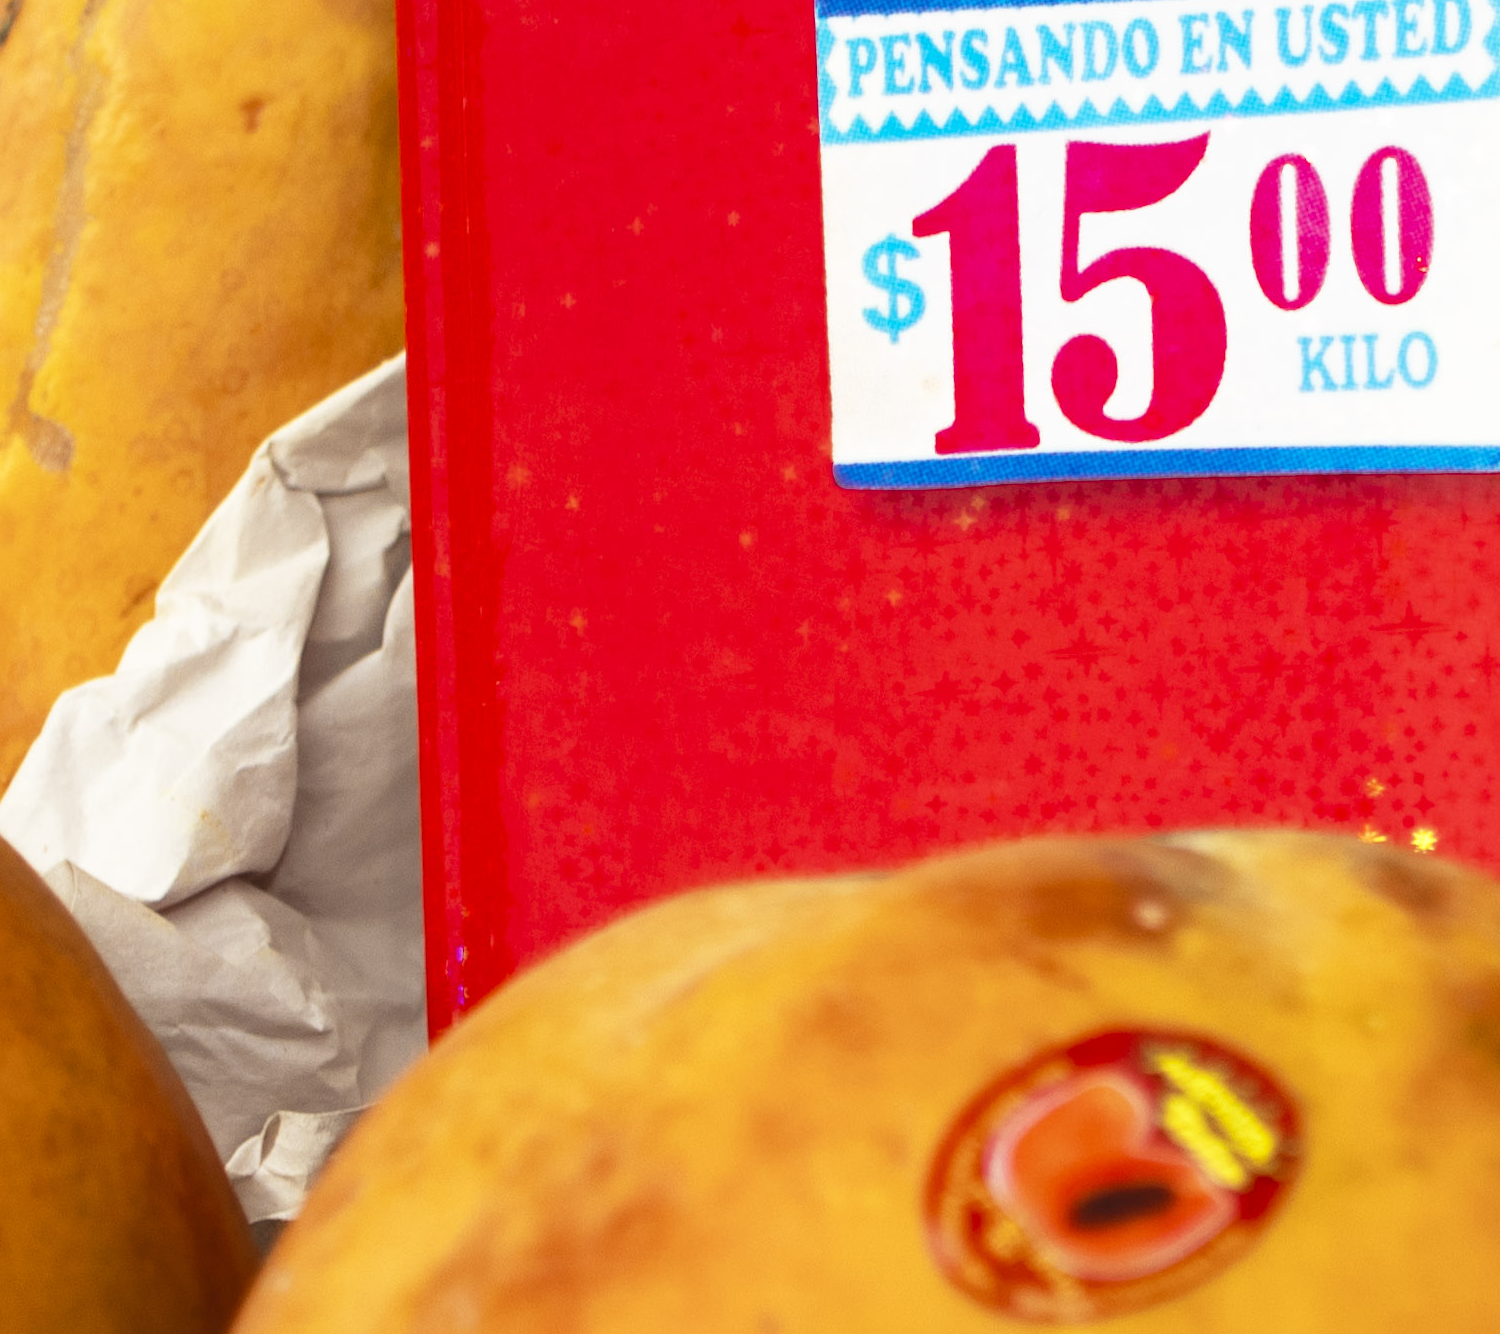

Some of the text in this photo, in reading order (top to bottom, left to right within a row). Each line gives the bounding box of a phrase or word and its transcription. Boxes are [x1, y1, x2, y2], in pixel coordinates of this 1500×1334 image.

[846, 17, 1160, 98] PENSANDO
[1180, 7, 1255, 74] EN
[1296, 330, 1439, 394] KILO
